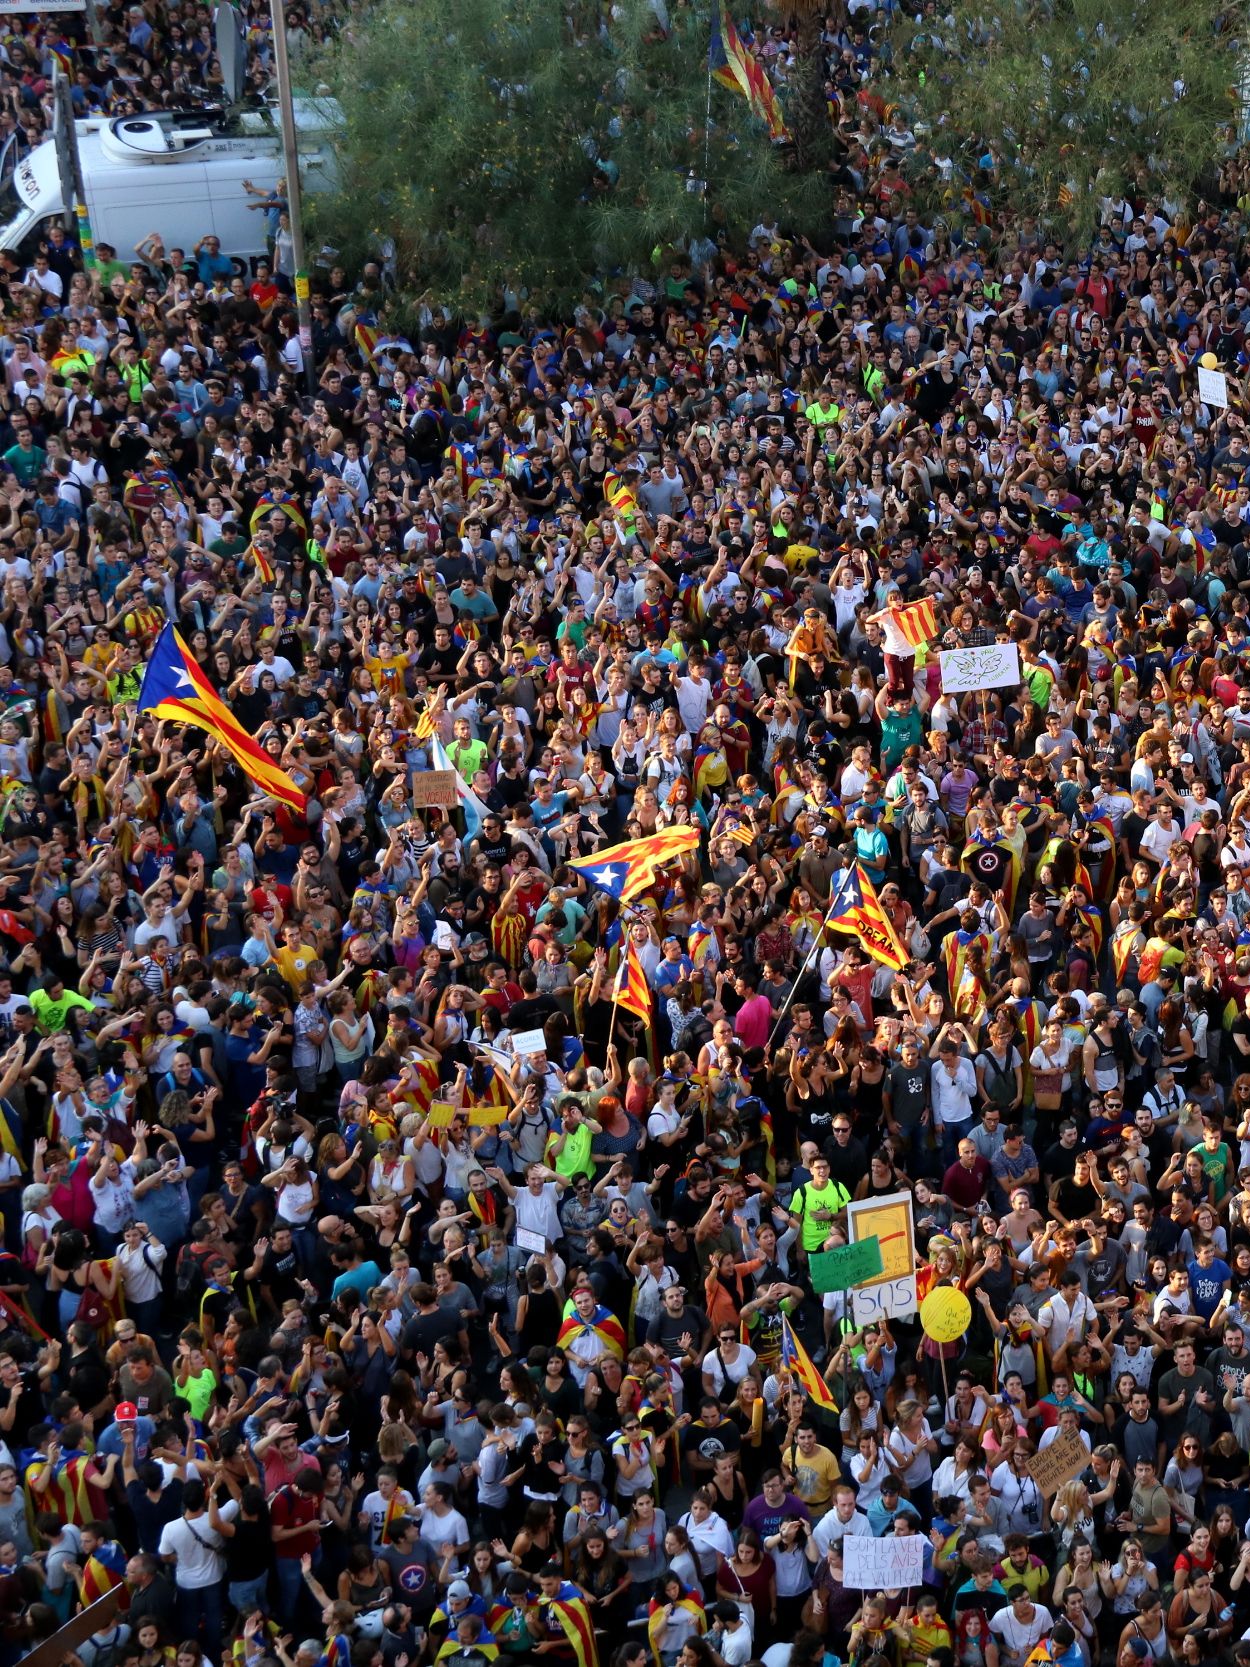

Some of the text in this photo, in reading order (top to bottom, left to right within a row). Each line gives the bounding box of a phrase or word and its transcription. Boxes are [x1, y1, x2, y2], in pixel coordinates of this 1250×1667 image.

[857, 919, 897, 956] DREAM
[858, 1278, 913, 1317] SOS
[1034, 1439, 1081, 1479] WHERE ARE OUR
[847, 1537, 922, 1554] SOM LA VEU
[858, 1552, 919, 1570] DELS AVIS
